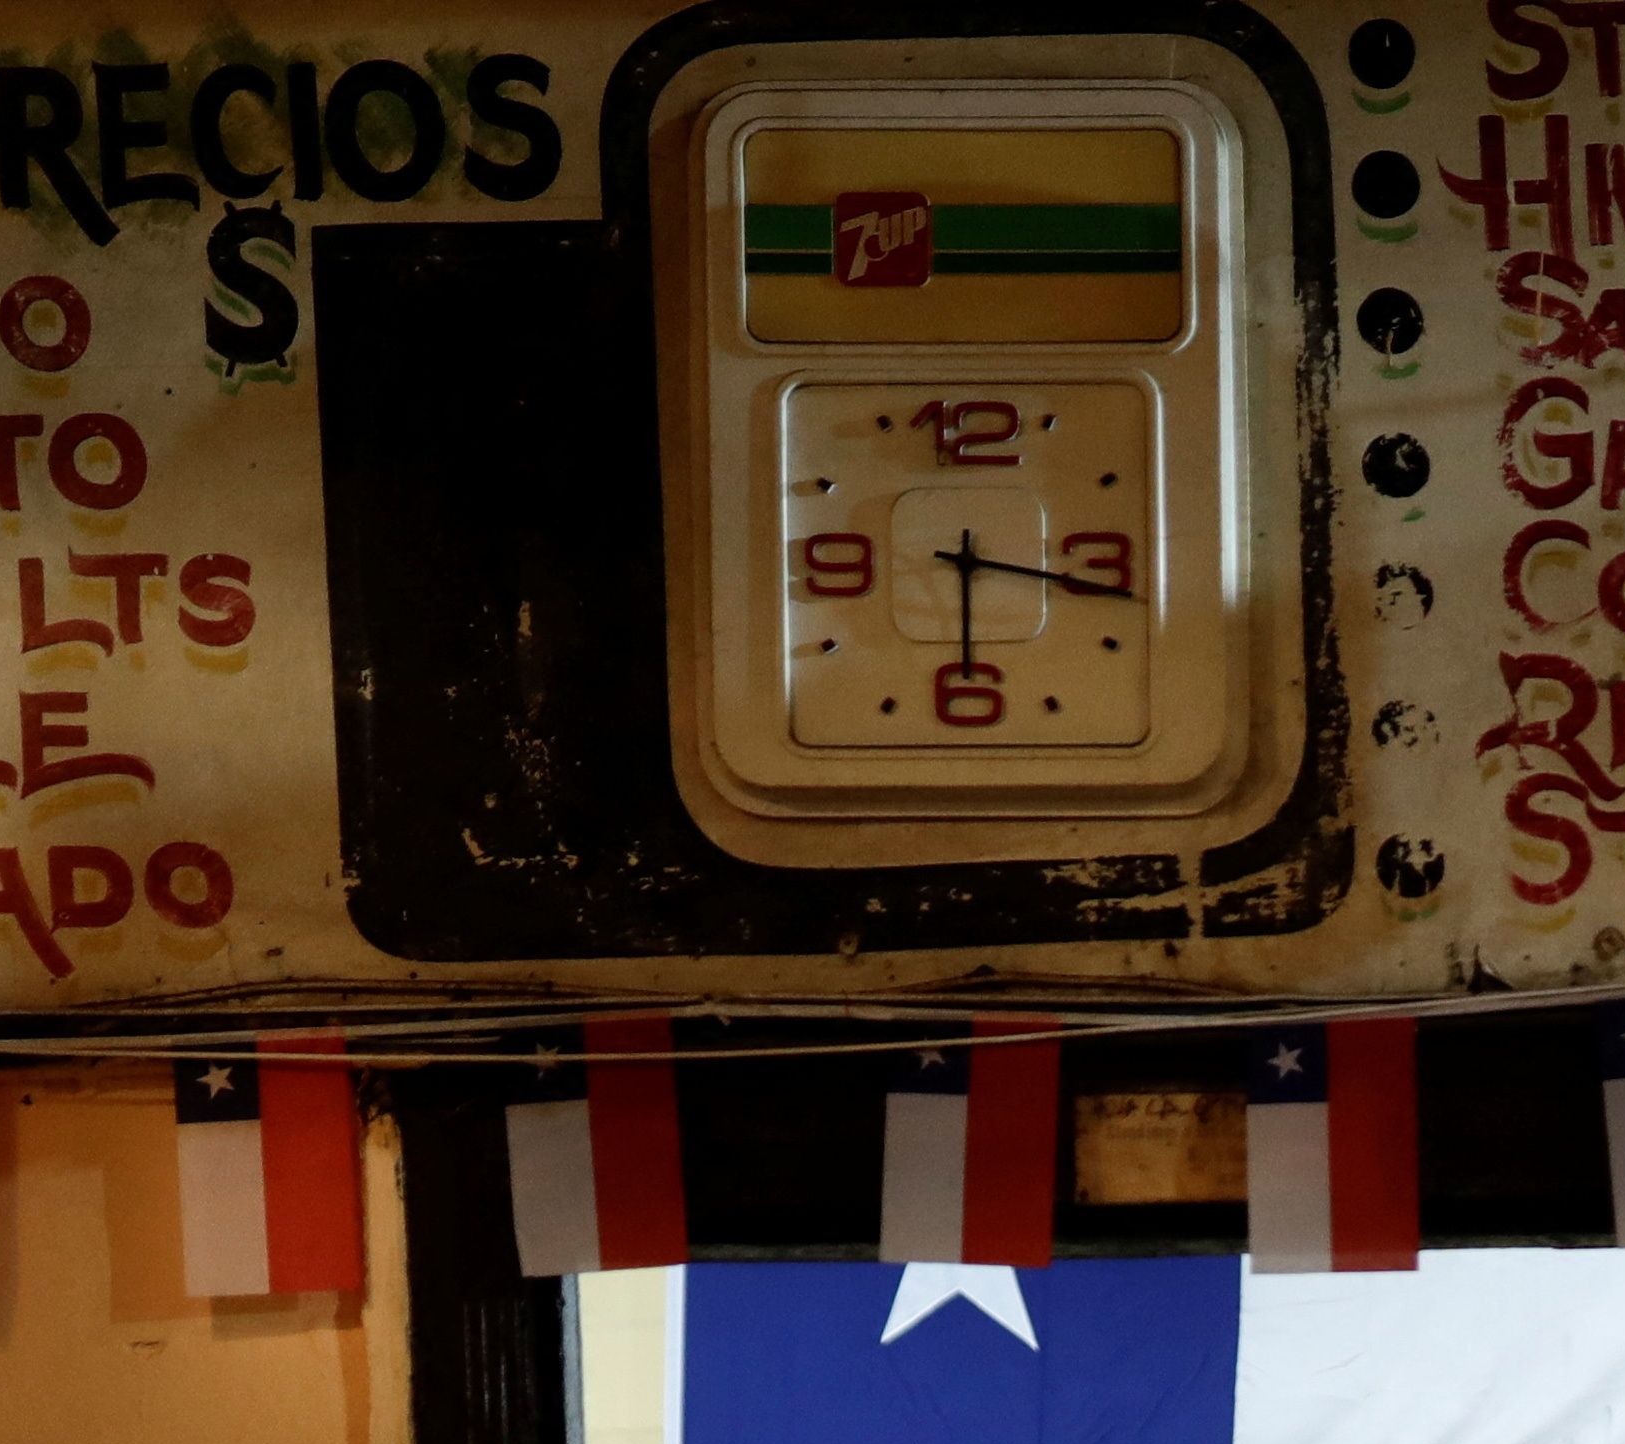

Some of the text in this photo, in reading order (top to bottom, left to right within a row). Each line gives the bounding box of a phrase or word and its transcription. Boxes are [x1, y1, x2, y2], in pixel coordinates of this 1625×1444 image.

[910, 401, 1022, 465] 12
[804, 531, 1133, 597] 9 3
[18, 546, 256, 657] LTS
[934, 661, 1005, 727] 6
